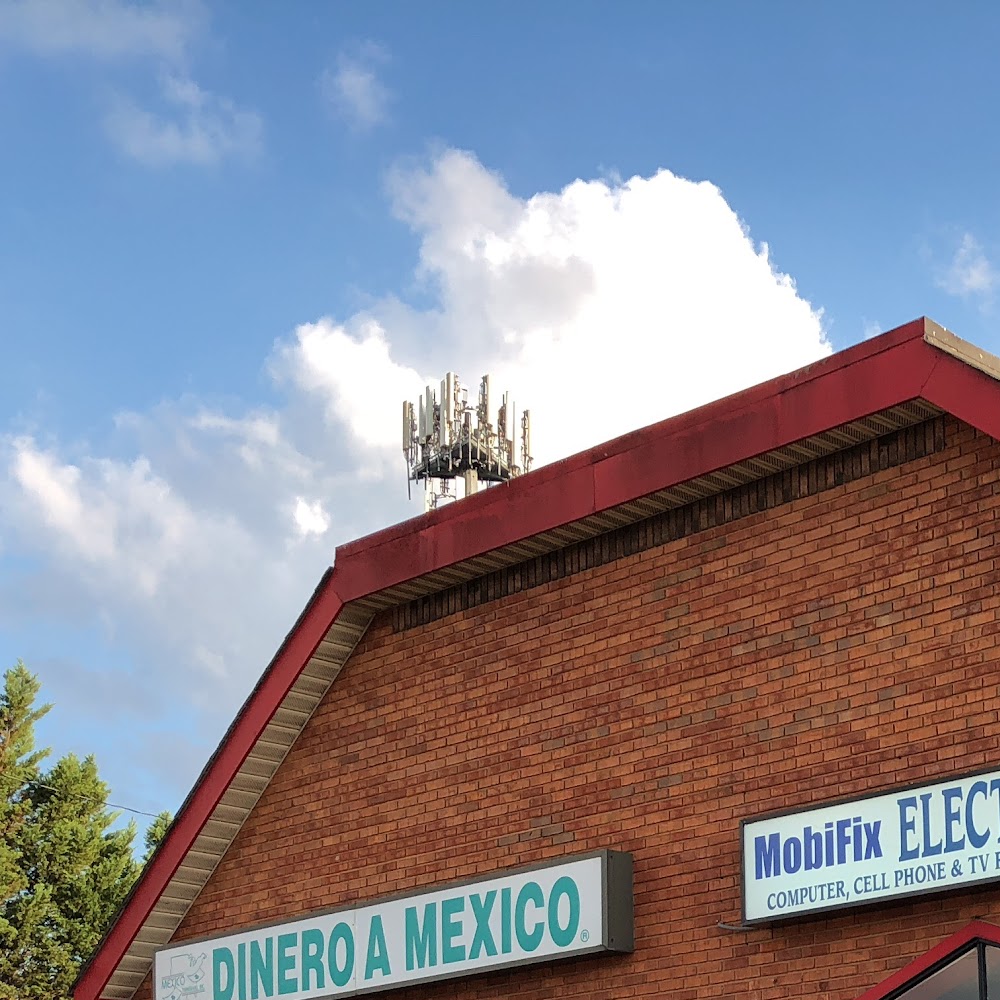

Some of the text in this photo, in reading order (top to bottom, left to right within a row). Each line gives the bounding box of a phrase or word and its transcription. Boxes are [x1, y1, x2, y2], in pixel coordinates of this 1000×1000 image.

[754, 816, 882, 881] MobiFix
[767, 881, 849, 911] COMPUTER,
[853, 873, 890, 895] CELL
[894, 862, 946, 888] PHONE
[950, 858, 963, 877] &
[968, 853, 991, 875] TV
[364, 914, 391, 981] A
[405, 876, 581, 971] MEXICO
